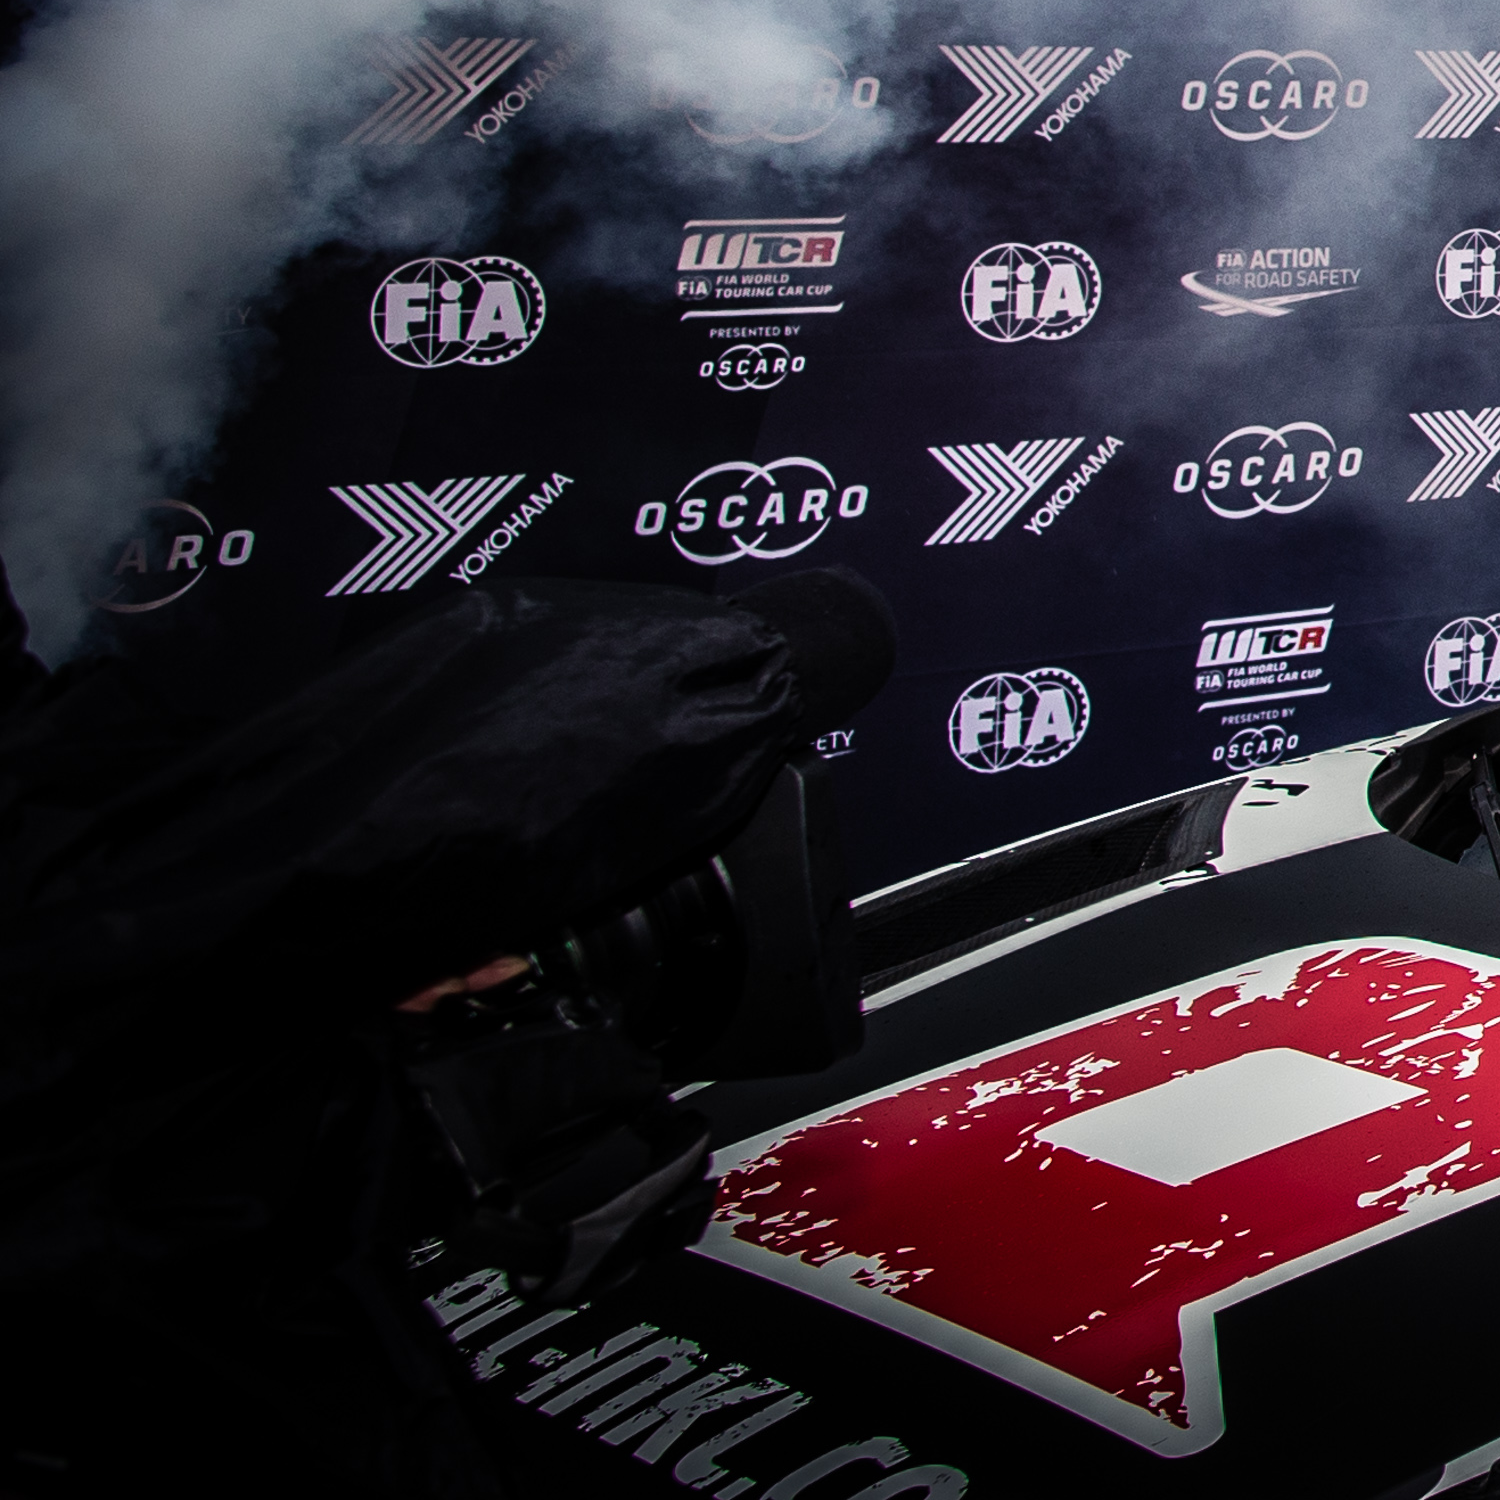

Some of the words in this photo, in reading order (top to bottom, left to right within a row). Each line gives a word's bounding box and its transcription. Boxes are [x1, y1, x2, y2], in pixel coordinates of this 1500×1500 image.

[1034, 46, 1134, 143] YOKOHAMA
[1181, 79, 1370, 111] OSCARO
[677, 231, 845, 271] WTCR
[1250, 246, 1330, 269] ACTION
[715, 286, 773, 298] TOURING
[776, 285, 804, 297] CAR
[806, 284, 833, 296] CUP
[716, 275, 737, 285] FIA
[741, 273, 790, 284] WORLD
[1215, 273, 1242, 288] FOR
[1244, 271, 1293, 289] ROAD
[1295, 267, 1361, 287] SAFETY
[709, 327, 782, 339] PRESENTED
[784, 326, 801, 337] BY
[700, 355, 806, 377] OSCARO
[1172, 446, 1364, 494] OSCARO
[1023, 434, 1124, 537] YOKOHAMA
[634, 484, 869, 537] OSCARO
[449, 471, 575, 586] YOKOHAMA
[1196, 619, 1334, 667] WTCR
[1226, 674, 1275, 690] TOURING
[1277, 671, 1299, 684] CAR
[1301, 667, 1323, 681] CUP
[1227, 667, 1245, 679] FIA
[1248, 662, 1288, 675] WORLD
[1220, 710, 1275, 727] PRESENTED
[1278, 707, 1297, 719] BY
[1212, 733, 1300, 762] OSCARO
